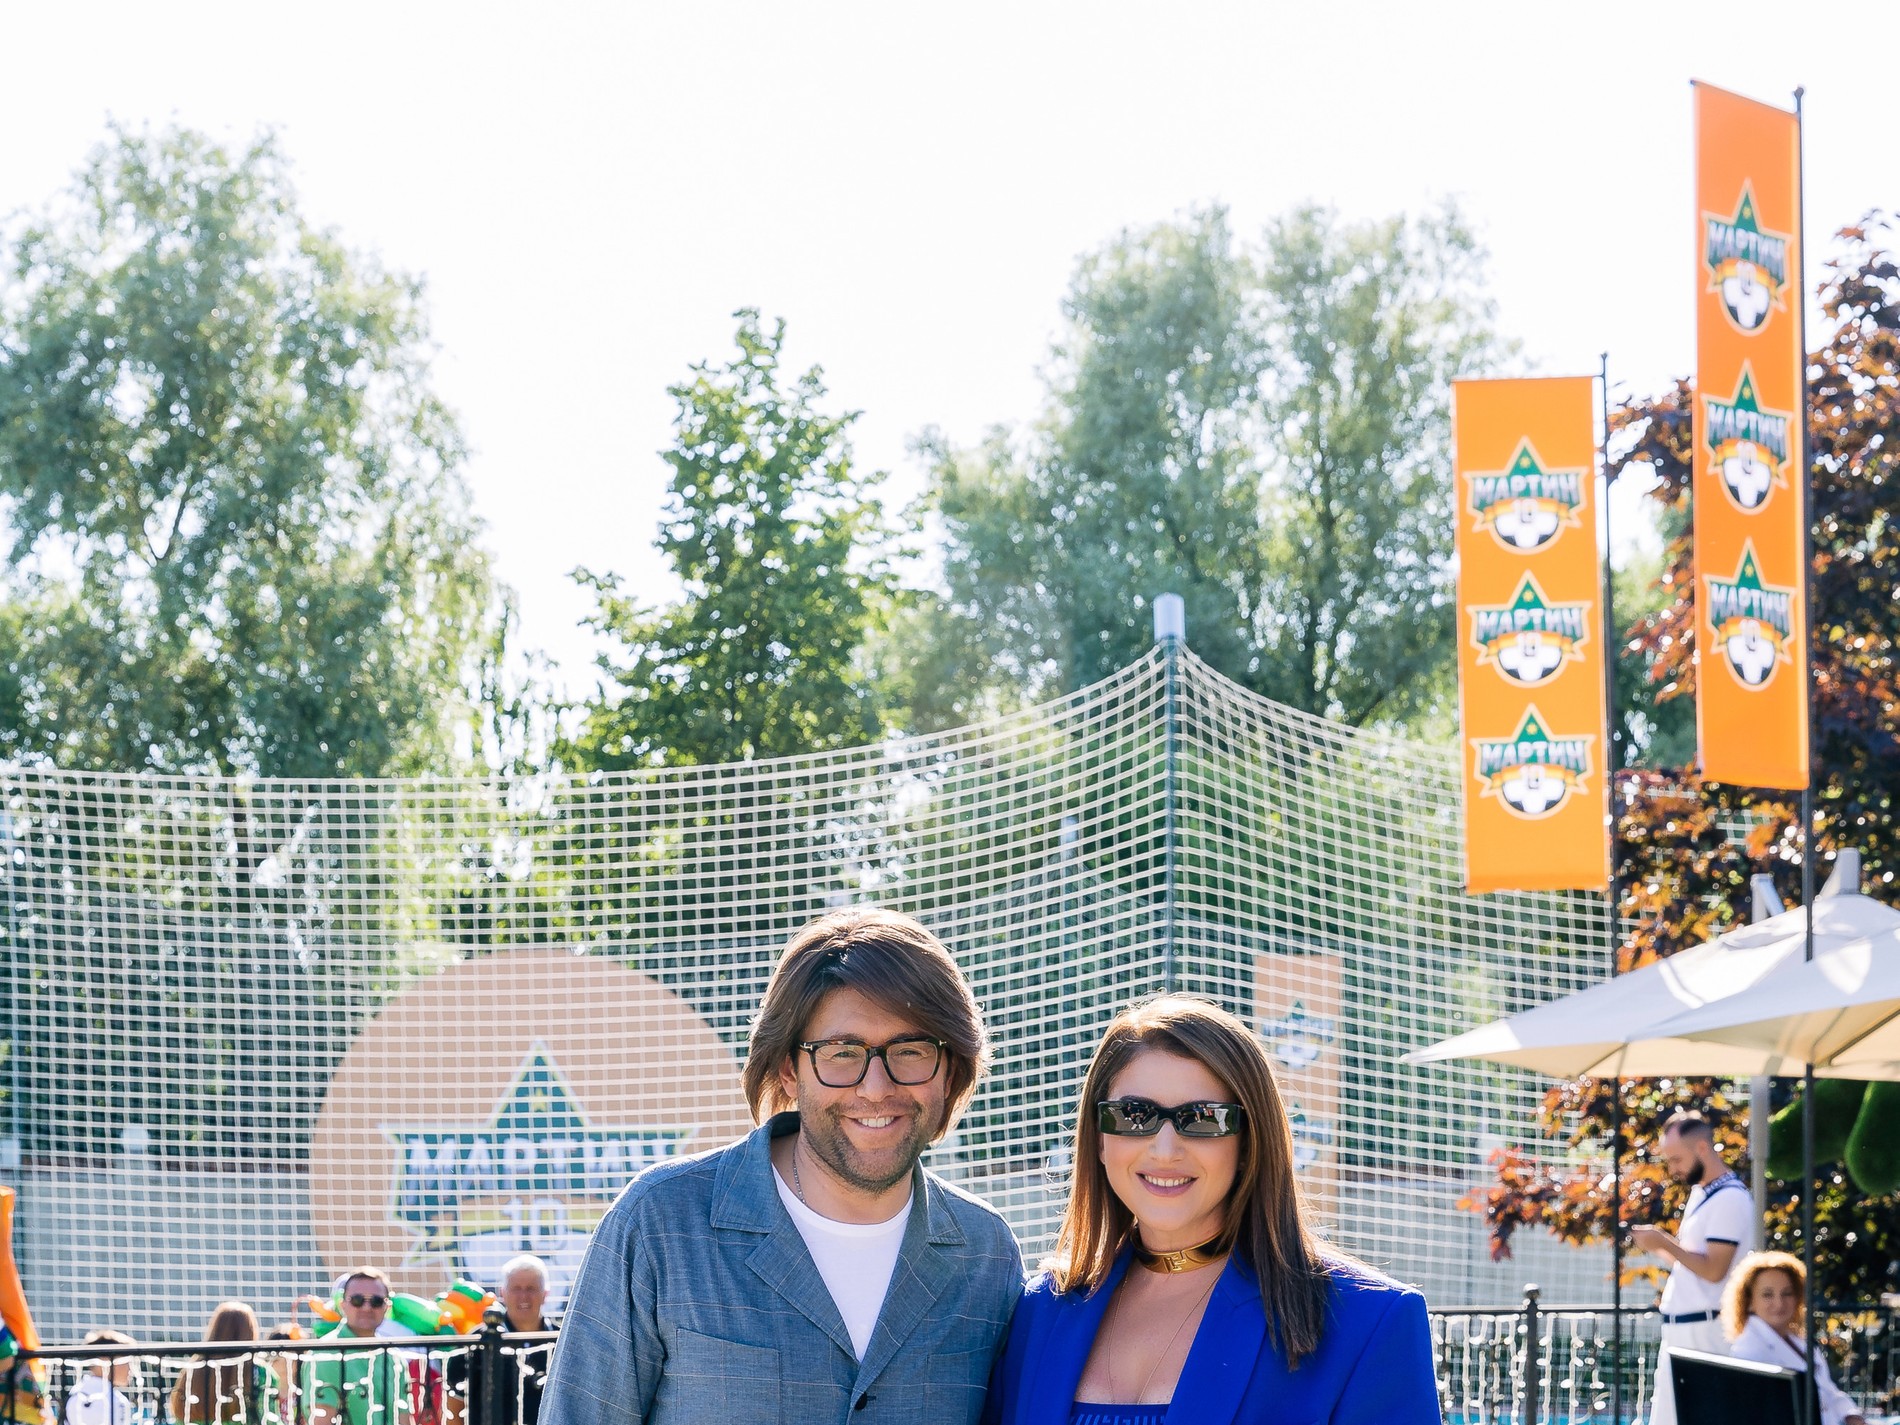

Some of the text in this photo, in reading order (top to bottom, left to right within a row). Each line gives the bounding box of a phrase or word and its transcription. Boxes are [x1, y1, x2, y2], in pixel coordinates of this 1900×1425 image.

[1473, 474, 1579, 508] МАРТИН
[1477, 608, 1583, 642] МАРТИН
[1480, 741, 1587, 776] МАРТИН
[502, 1198, 569, 1252] 10
